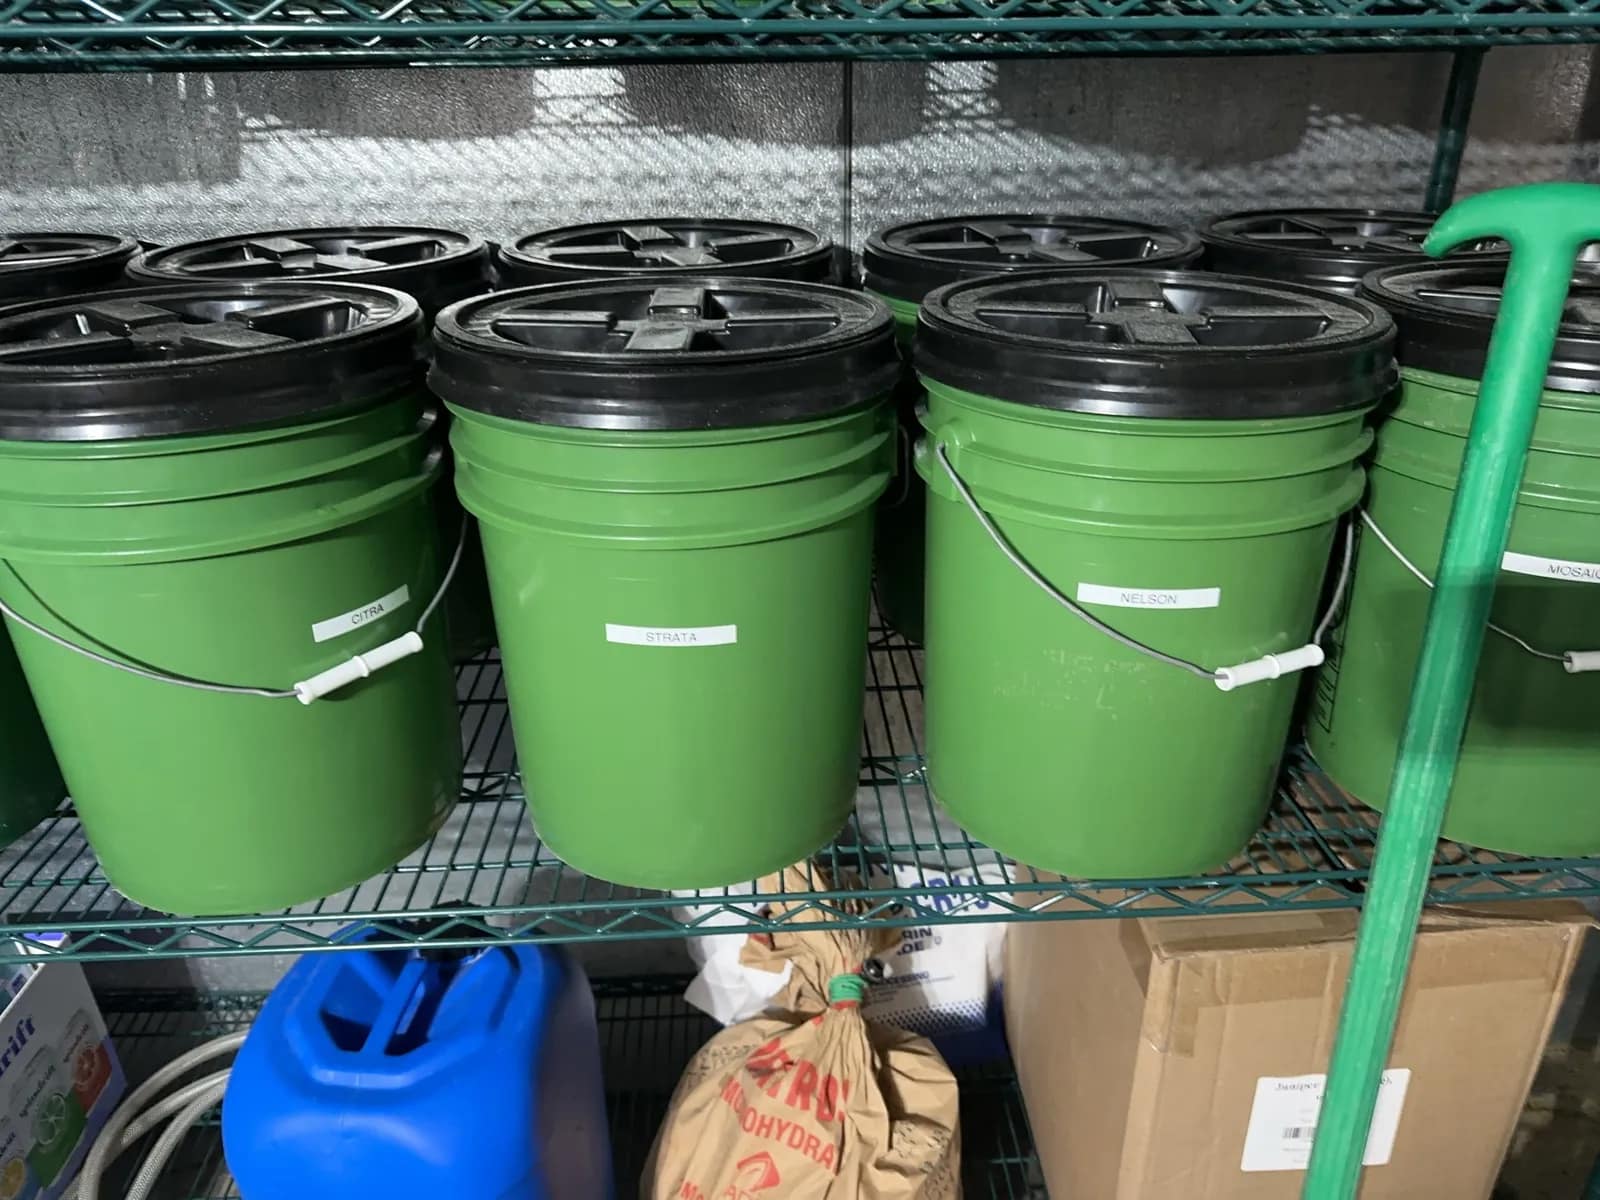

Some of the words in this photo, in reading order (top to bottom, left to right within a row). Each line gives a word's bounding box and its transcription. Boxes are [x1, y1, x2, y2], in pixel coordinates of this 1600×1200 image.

[1120, 590, 1179, 607] NELSON
[351, 603, 385, 624] CITRA
[645, 630, 698, 644] STRATA
